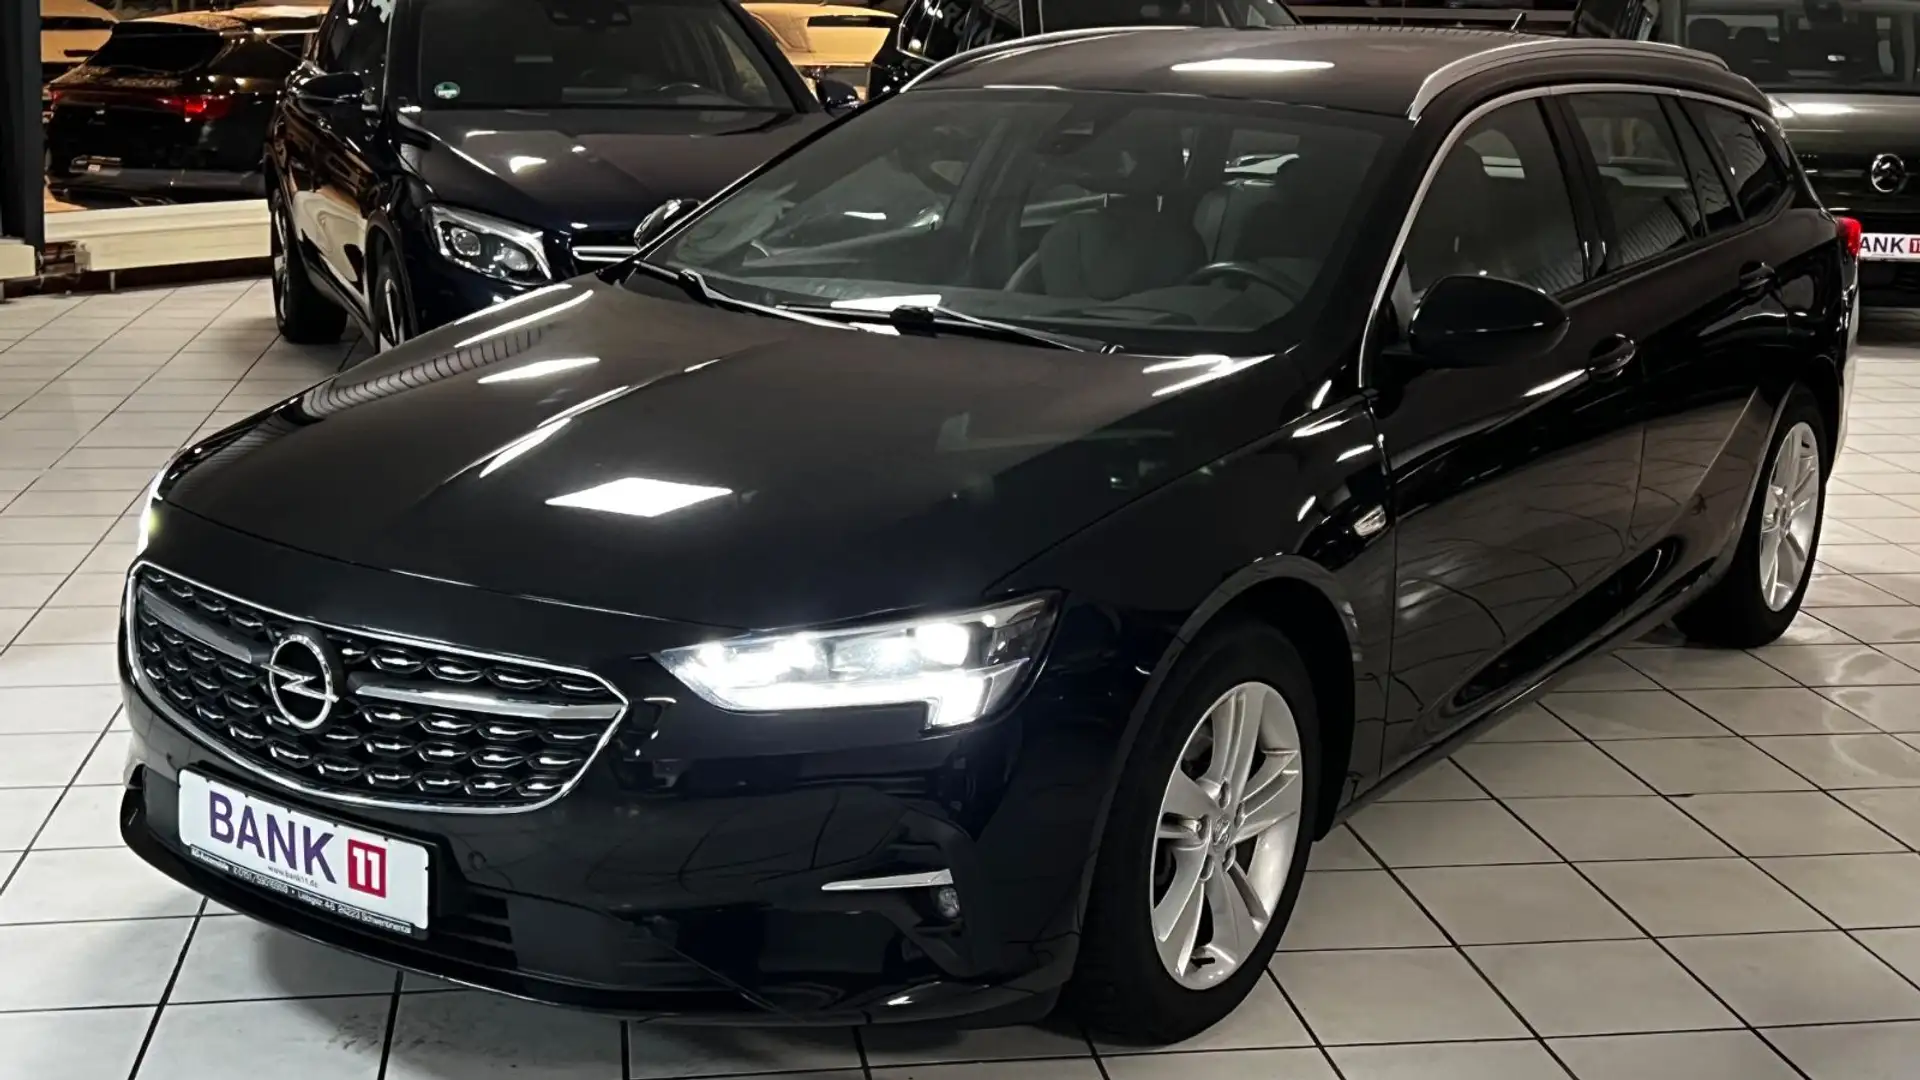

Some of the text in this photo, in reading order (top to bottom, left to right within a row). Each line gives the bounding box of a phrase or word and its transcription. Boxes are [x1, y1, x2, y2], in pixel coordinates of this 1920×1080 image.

[1860, 236, 1905, 254] ANK
[209, 790, 381, 892] BANK 11
